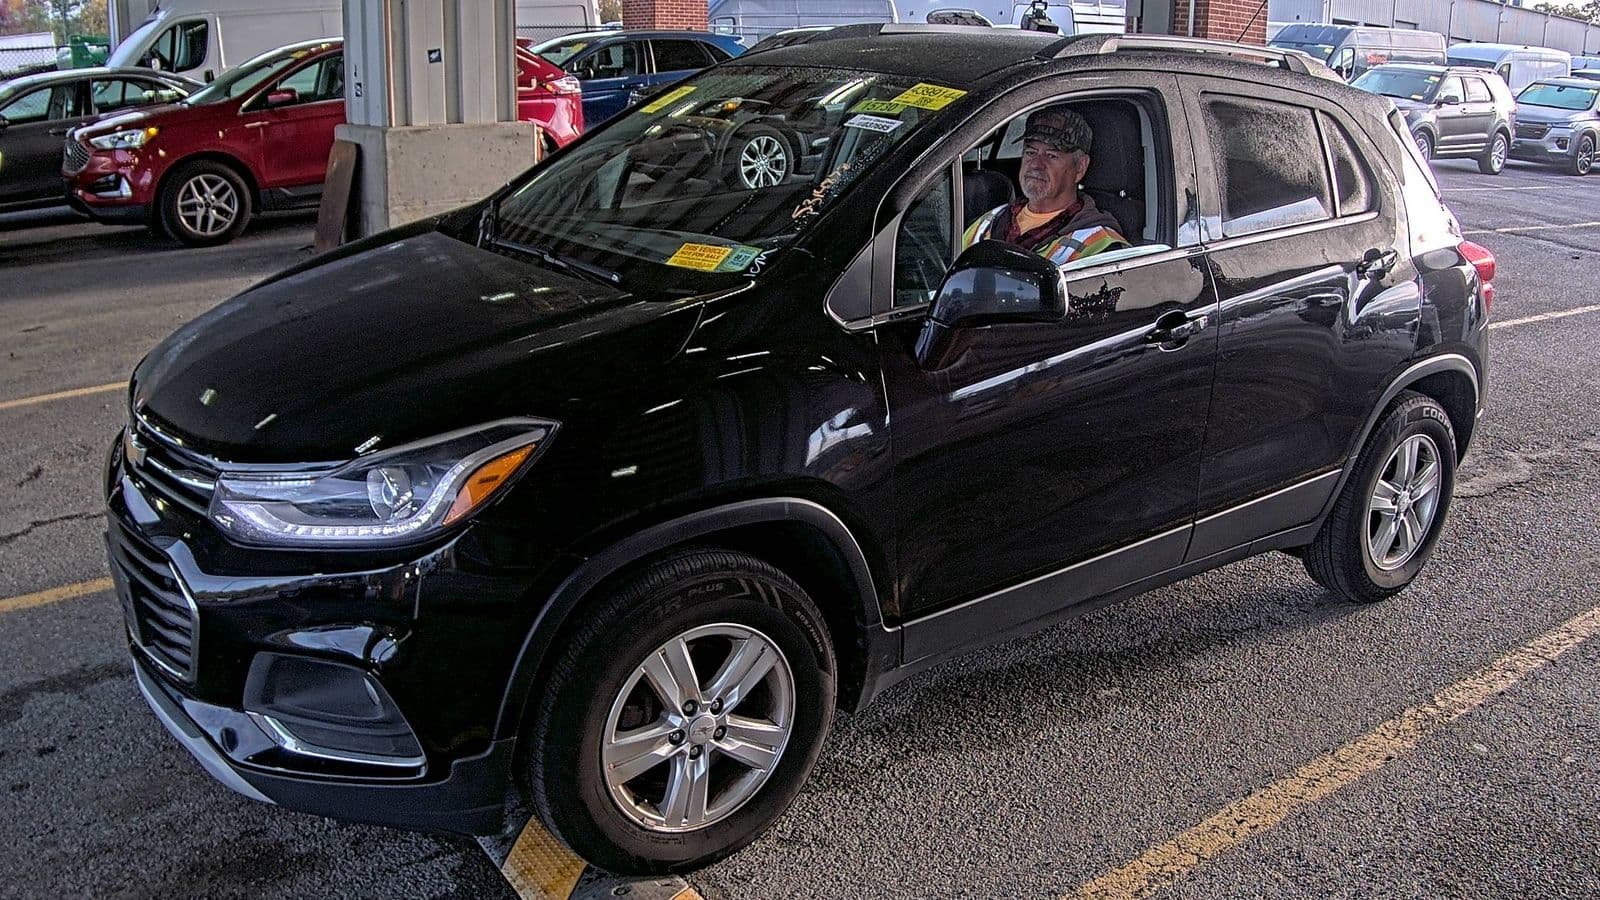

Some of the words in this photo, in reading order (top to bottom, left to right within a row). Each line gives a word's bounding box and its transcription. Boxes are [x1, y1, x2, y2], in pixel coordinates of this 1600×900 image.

[699, 246, 729, 256] VEHICLE
[705, 252, 721, 260] SALE
[687, 582, 724, 598] PLUS
